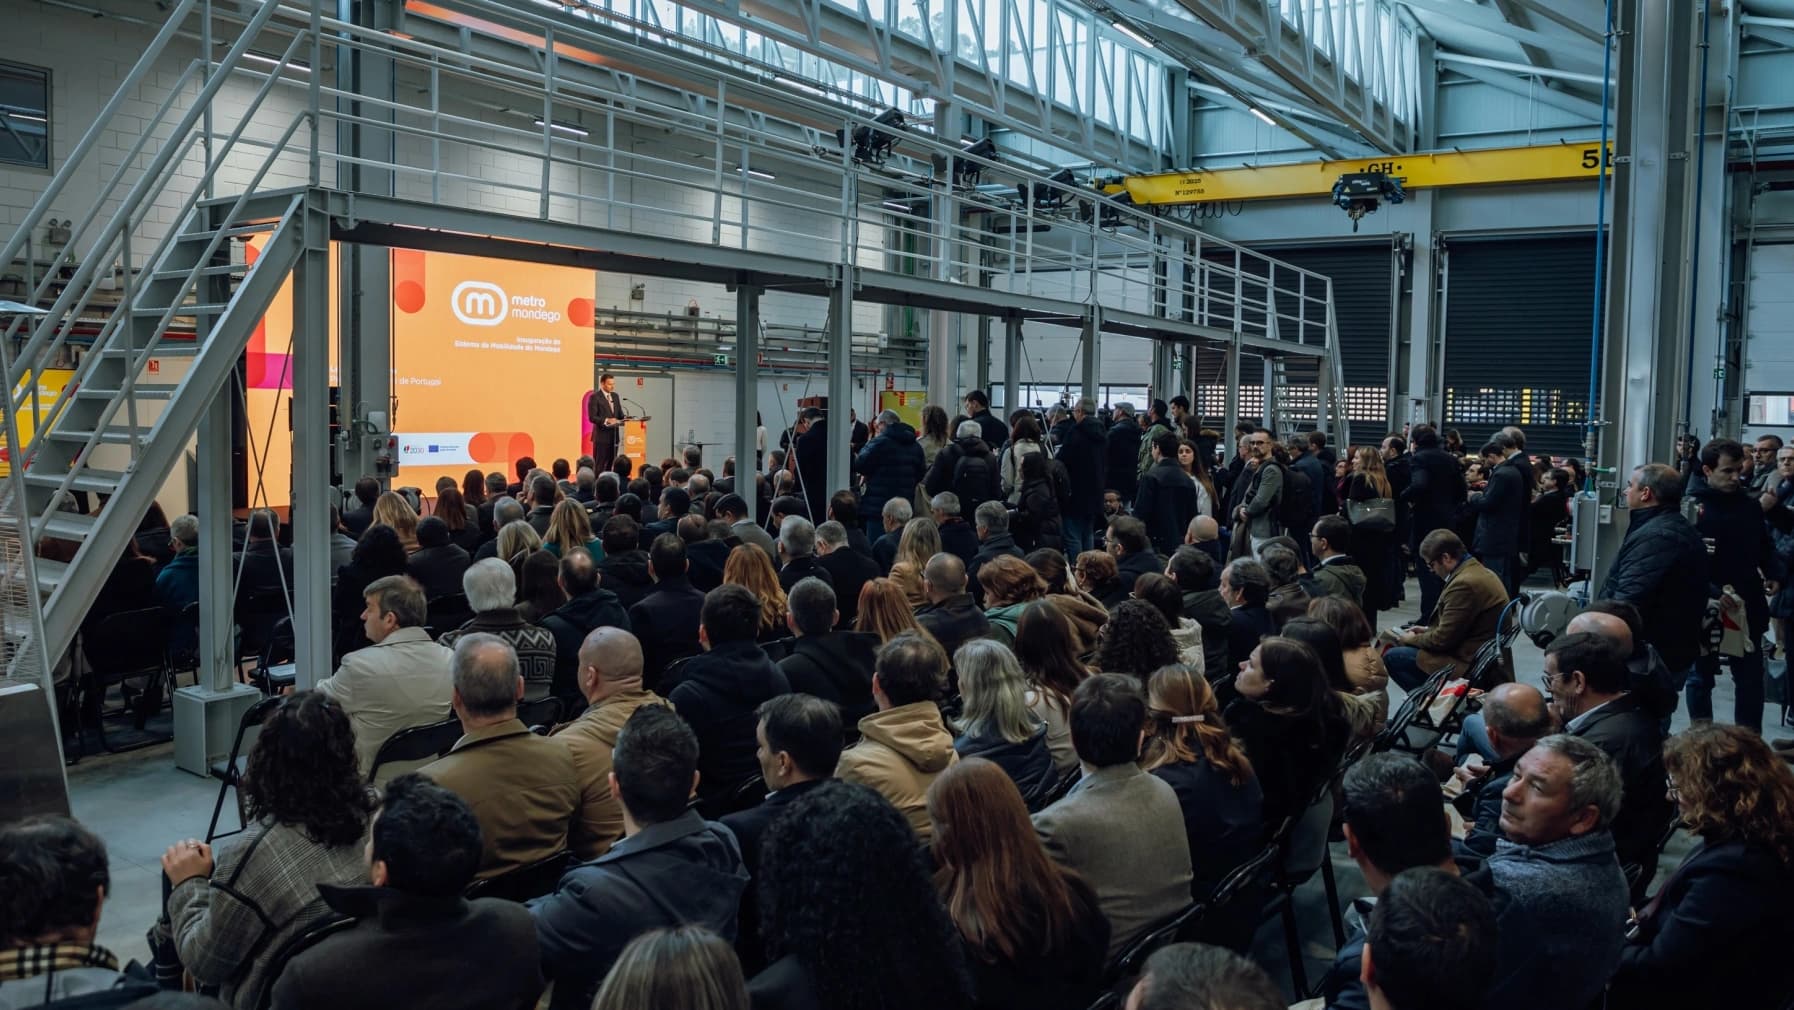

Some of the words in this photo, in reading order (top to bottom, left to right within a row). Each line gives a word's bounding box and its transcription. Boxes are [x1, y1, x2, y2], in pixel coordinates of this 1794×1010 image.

[1367, 162, 1394, 174] GH
[511, 295, 546, 308] metro
[511, 308, 561, 323] mondego
[399, 376, 409, 385] de
[410, 376, 442, 387] Portugal
